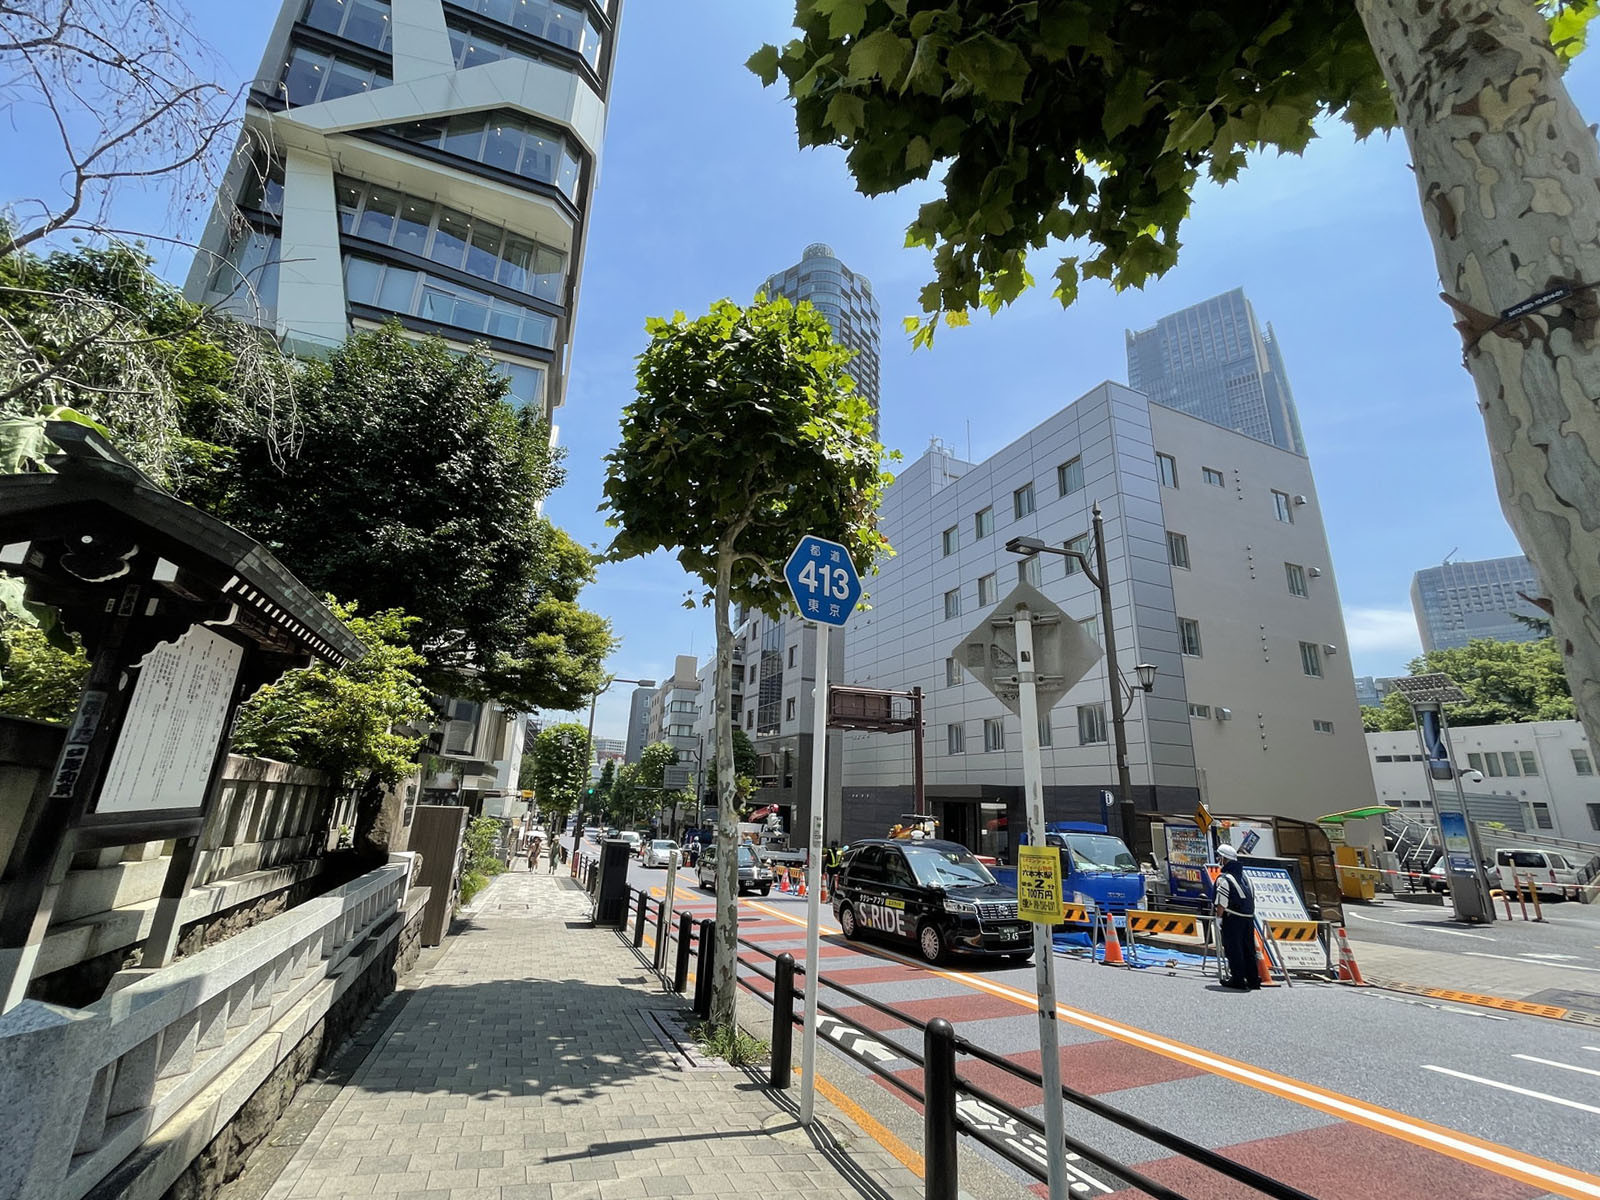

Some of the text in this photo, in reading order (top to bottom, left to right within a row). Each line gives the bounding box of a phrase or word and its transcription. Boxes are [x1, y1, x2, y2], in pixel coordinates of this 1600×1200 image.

[798, 560, 849, 600] 413
[808, 599, 840, 617] 東京
[1022, 869, 1053, 879] 六本木駅
